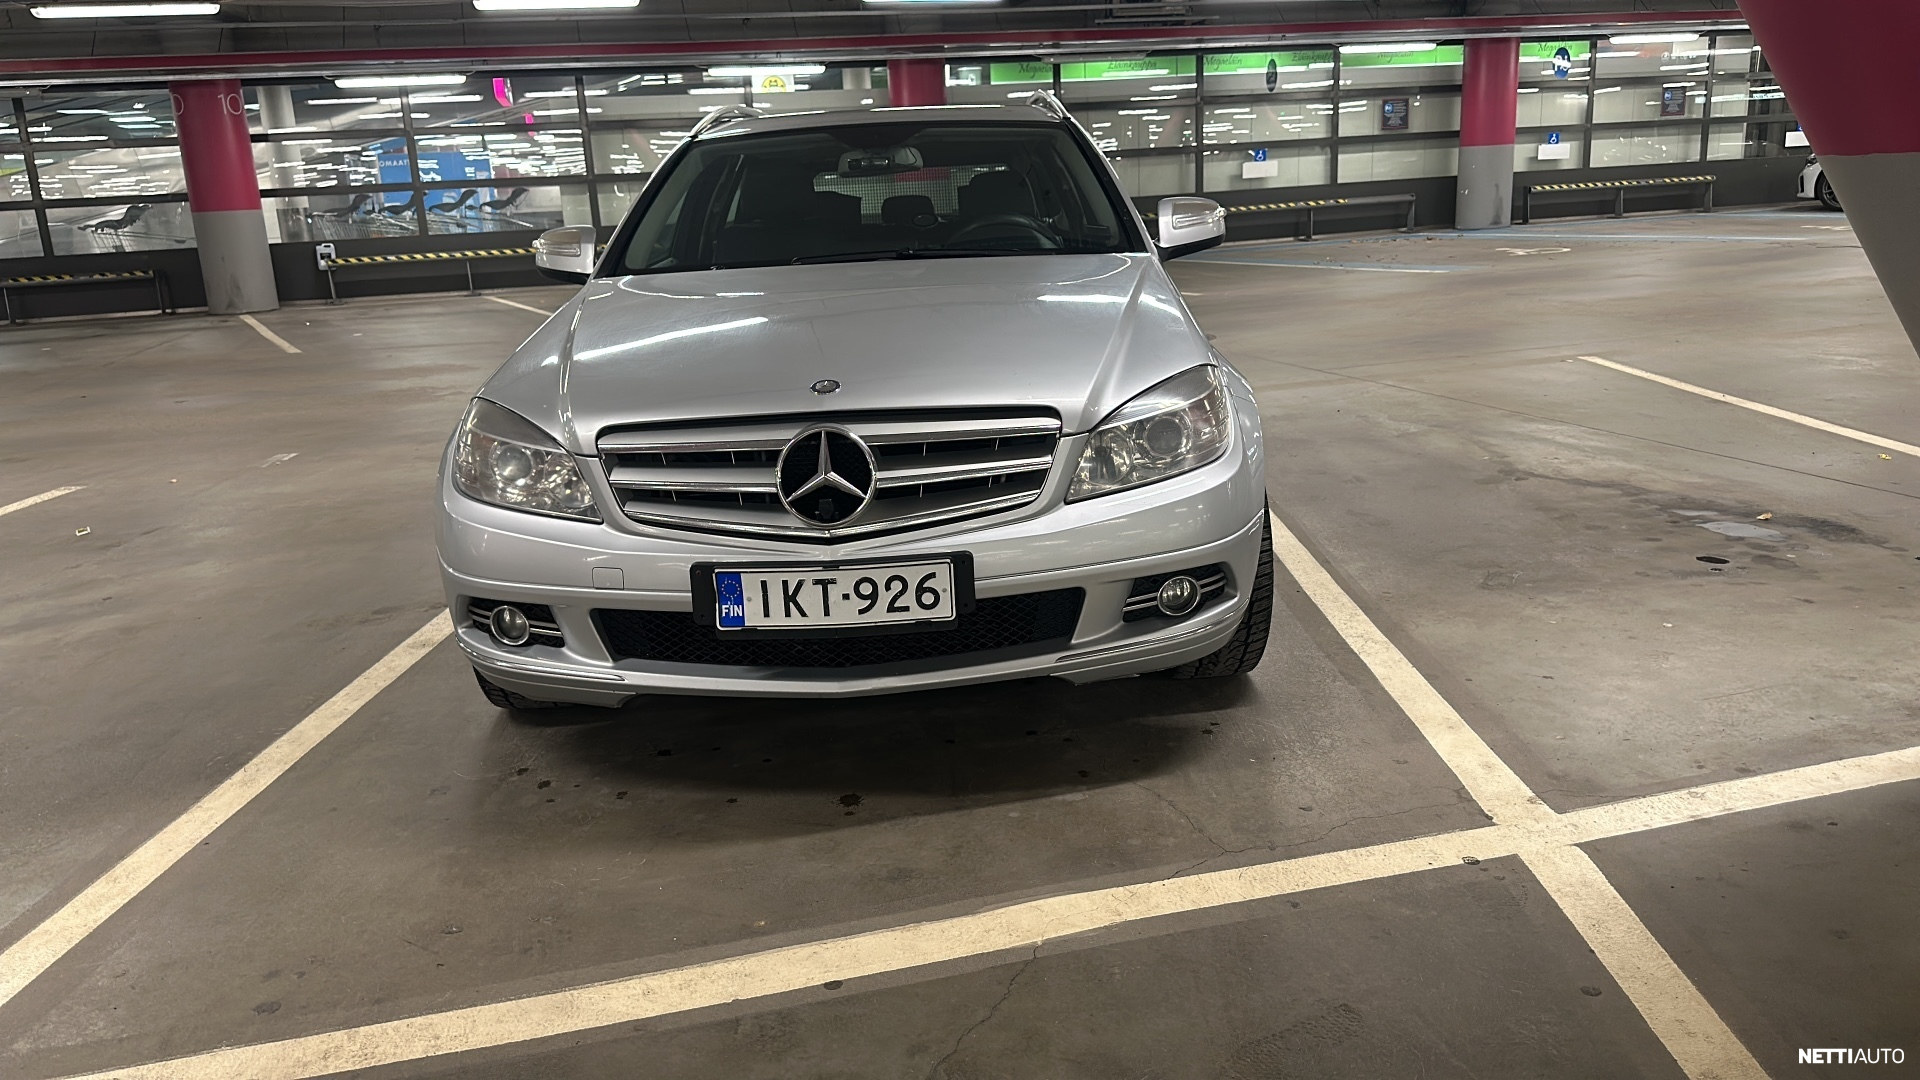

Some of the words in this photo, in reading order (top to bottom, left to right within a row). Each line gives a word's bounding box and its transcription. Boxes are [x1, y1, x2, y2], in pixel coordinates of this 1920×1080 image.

[217, 93, 242, 115] 10
[760, 571, 941, 618] IKT-926
[722, 604, 743, 617] FIN
